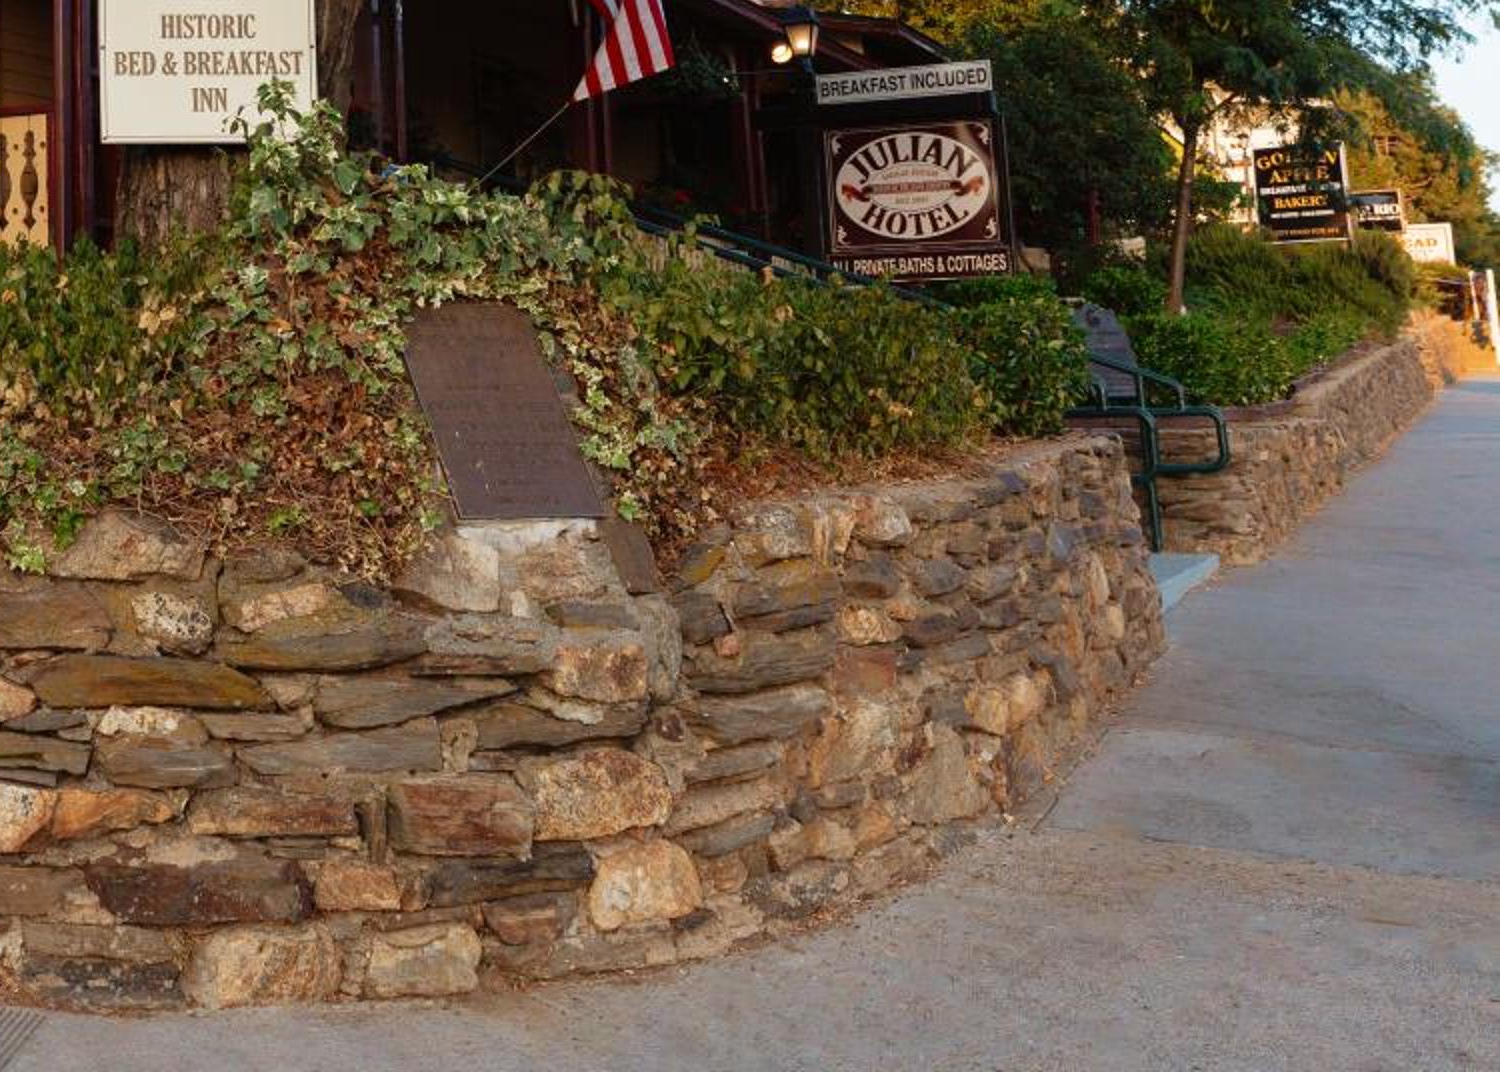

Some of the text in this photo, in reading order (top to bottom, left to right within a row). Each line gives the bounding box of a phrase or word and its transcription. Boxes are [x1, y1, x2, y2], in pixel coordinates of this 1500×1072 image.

[160, 14, 257, 40] HISTORIC
[114, 50, 304, 76] BED & BREAKFAST
[820, 67, 988, 98] BREAKFAST INCLUDED
[192, 88, 229, 113] INN
[848, 135, 981, 185] JULIAN
[861, 203, 971, 237] HOTEL
[853, 258, 897, 275] PRIVATE
[899, 257, 934, 274] BATHS
[937, 256, 946, 273] &
[947, 253, 1007, 272] COTTAGES
